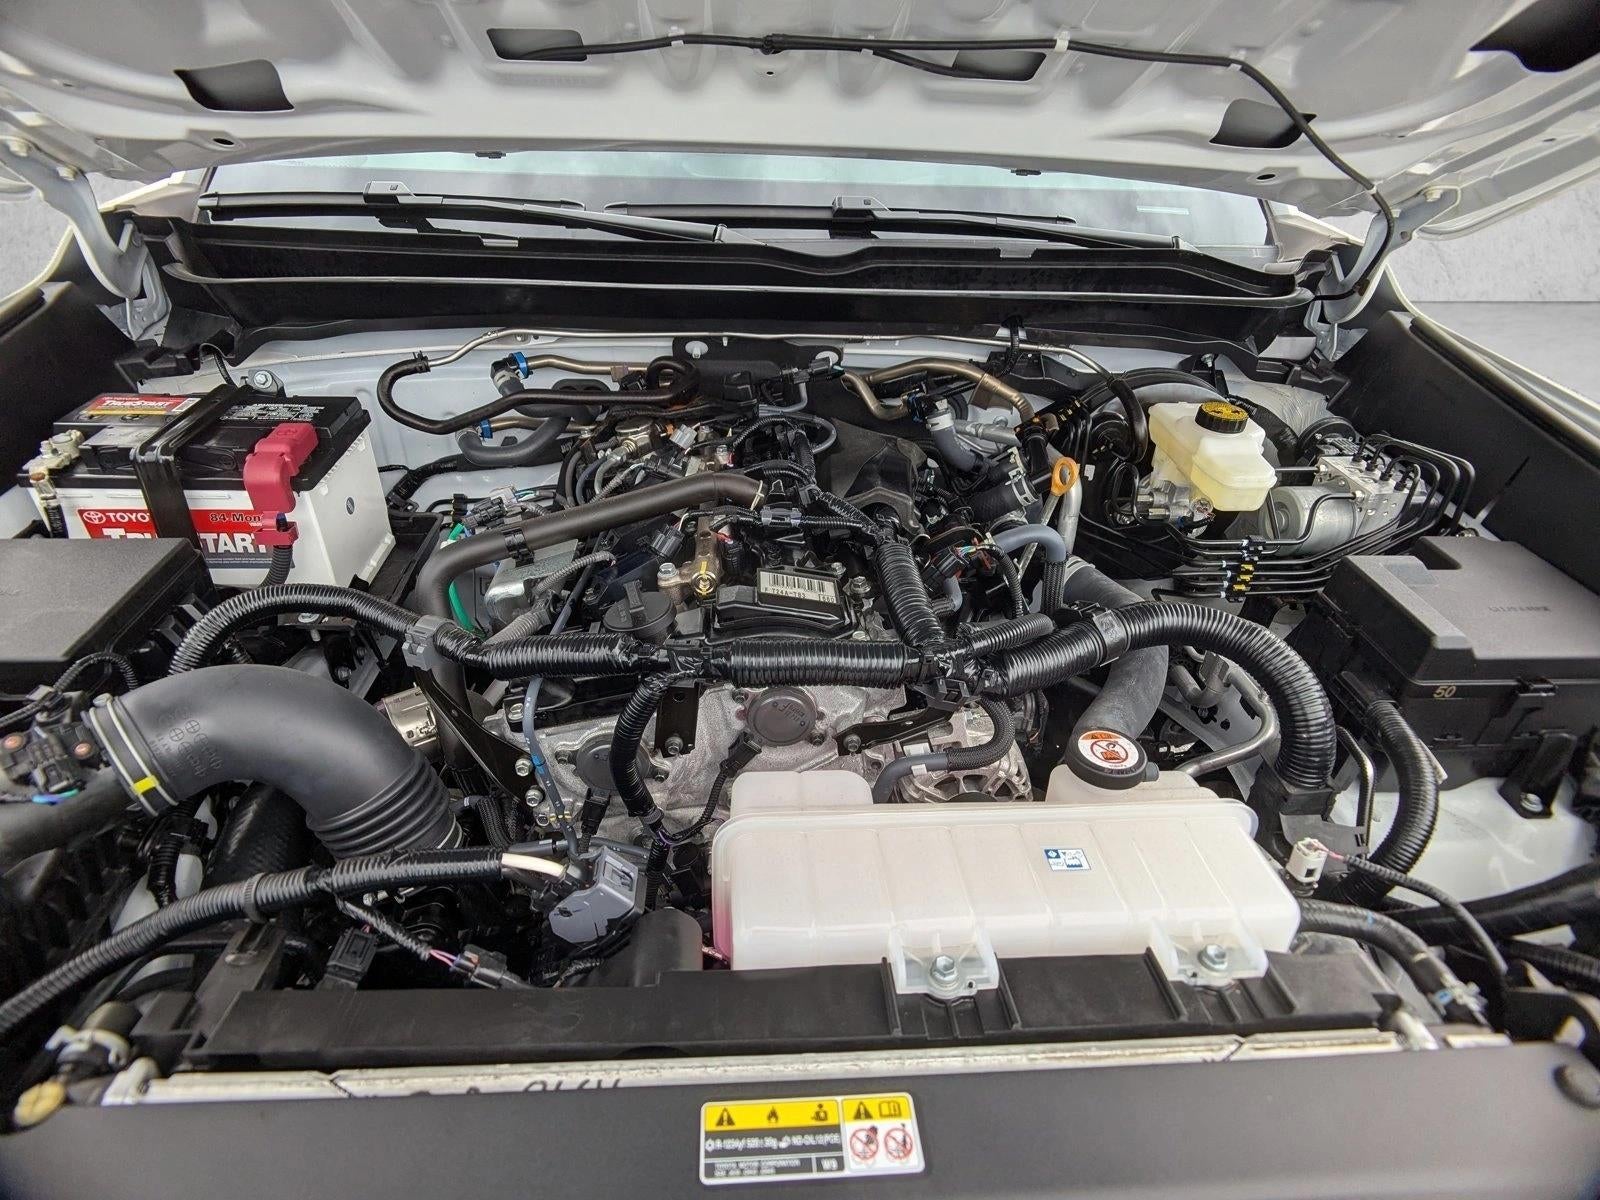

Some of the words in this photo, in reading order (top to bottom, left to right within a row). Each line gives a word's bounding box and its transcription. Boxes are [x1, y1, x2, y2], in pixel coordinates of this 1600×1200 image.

[105, 512, 151, 523] TOYO
[231, 512, 264, 522] Mon
[197, 532, 267, 553] TAR
[1433, 685, 1457, 698] 50
